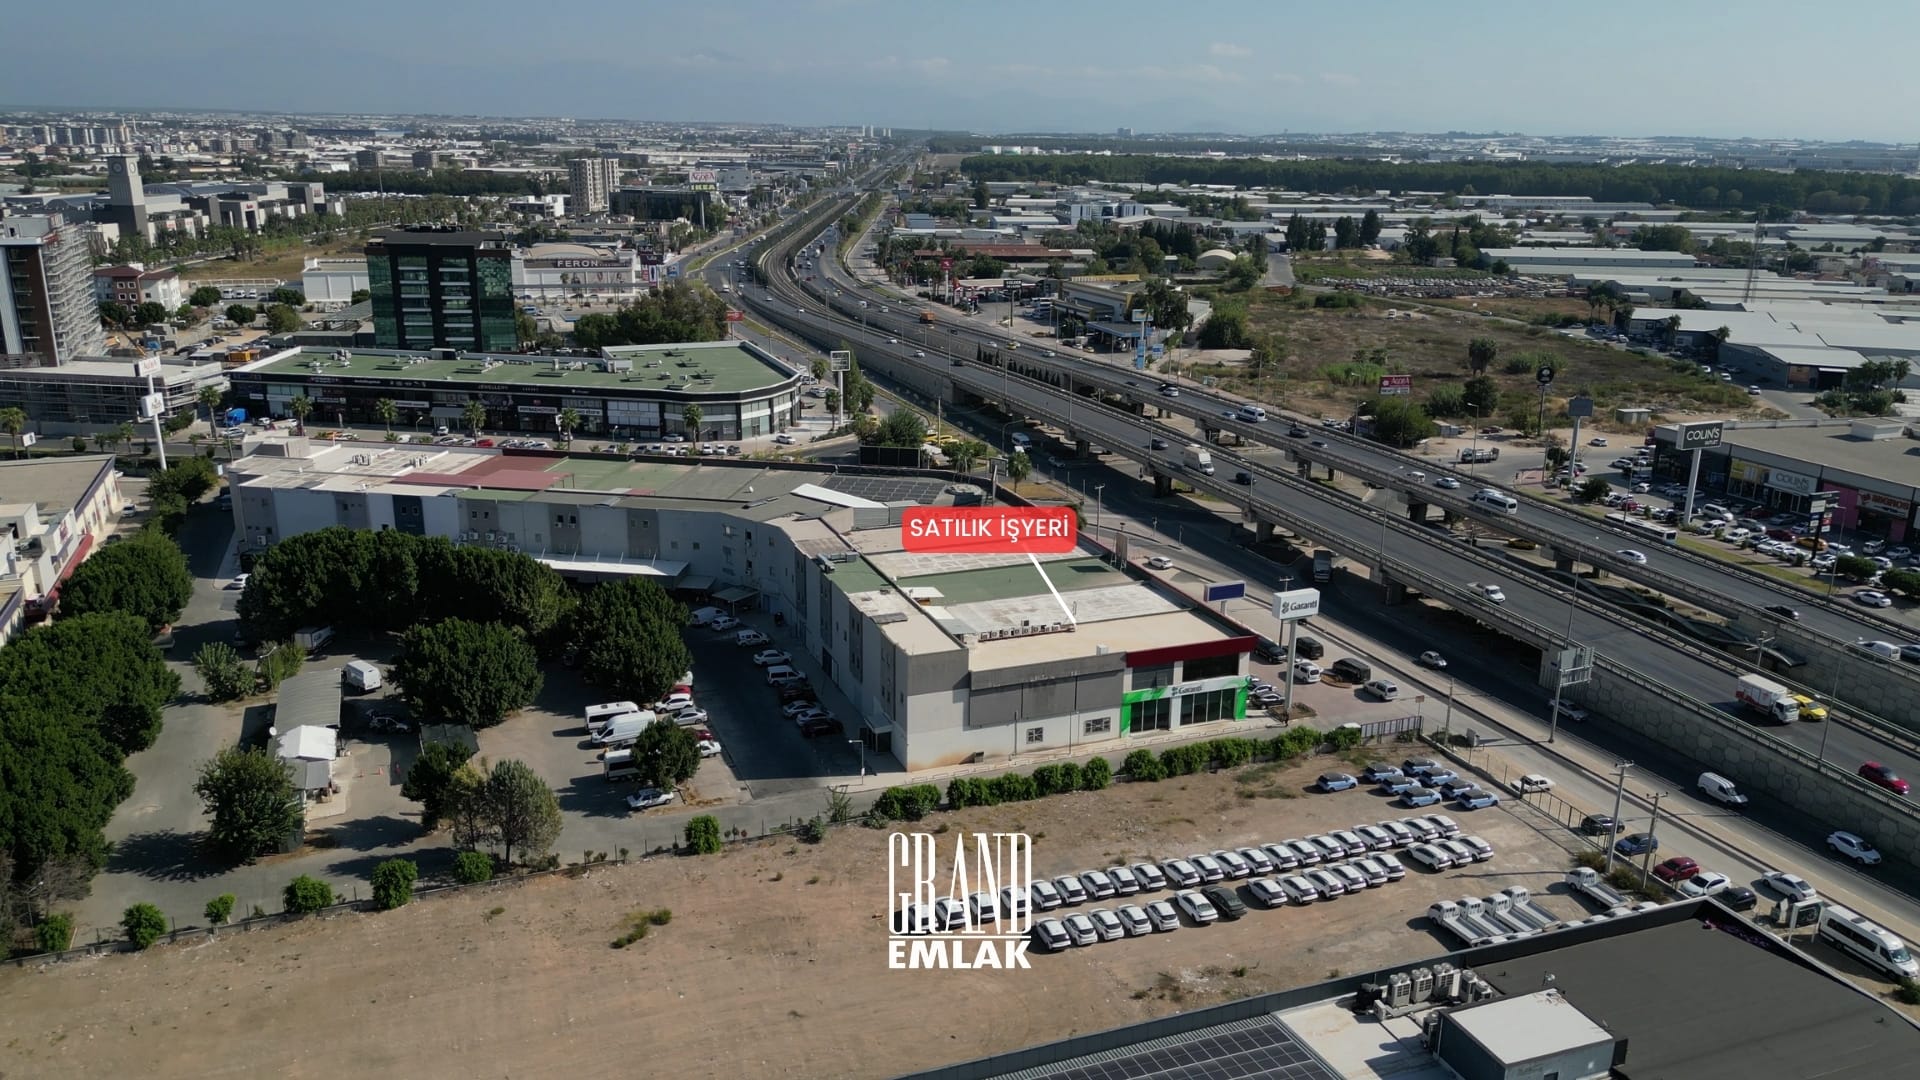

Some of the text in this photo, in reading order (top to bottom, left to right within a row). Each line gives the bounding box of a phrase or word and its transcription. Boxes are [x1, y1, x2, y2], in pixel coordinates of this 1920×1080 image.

[1686, 427, 1720, 441] COLIN'S
[1776, 473, 1809, 487] COLIN'S
[1290, 600, 1318, 611] Garanti
[1178, 685, 1202, 695] Garanti
